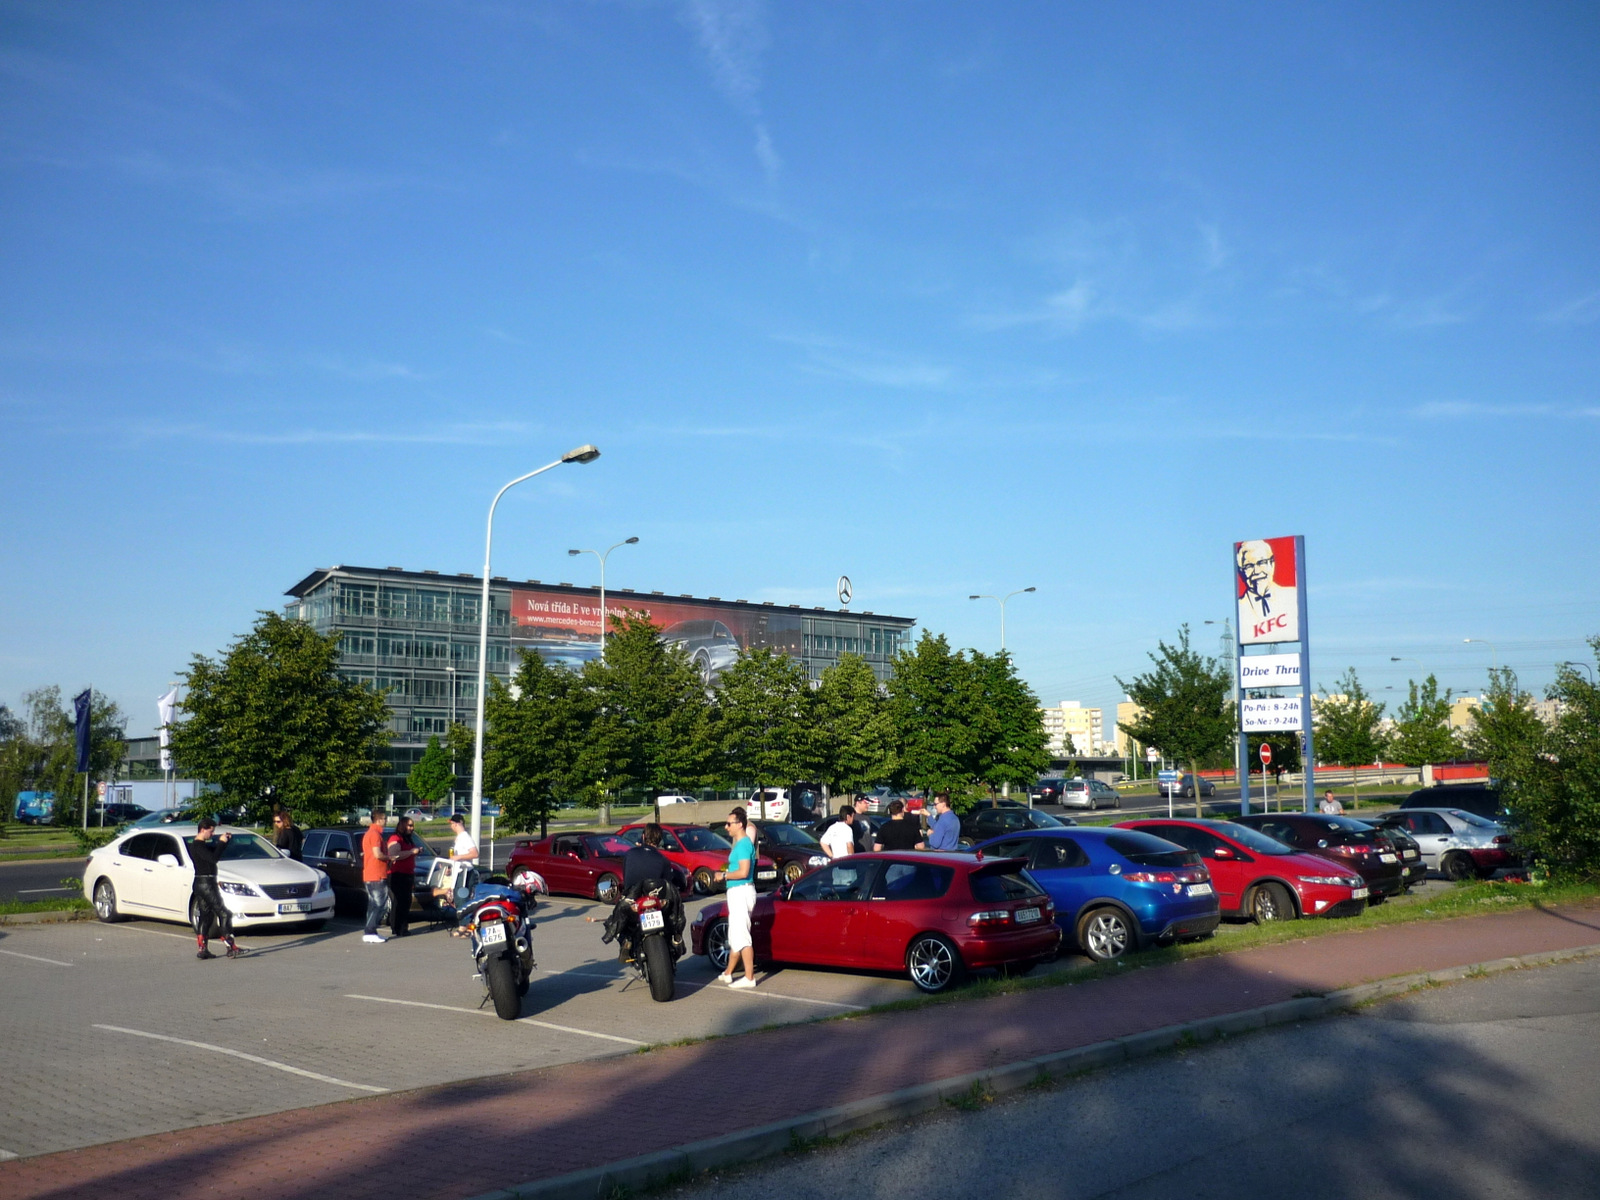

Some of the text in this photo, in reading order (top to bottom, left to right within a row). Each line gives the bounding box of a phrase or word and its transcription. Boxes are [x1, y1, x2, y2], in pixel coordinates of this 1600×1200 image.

[527, 599, 549, 612] Nová
[551, 601, 571, 614] třída
[573, 603, 579, 615] E
[581, 606, 590, 616] ve
[1253, 613, 1288, 638] KFC
[1242, 665, 1300, 677] Drive Thru
[1273, 717, 1298, 726] 9-24h
